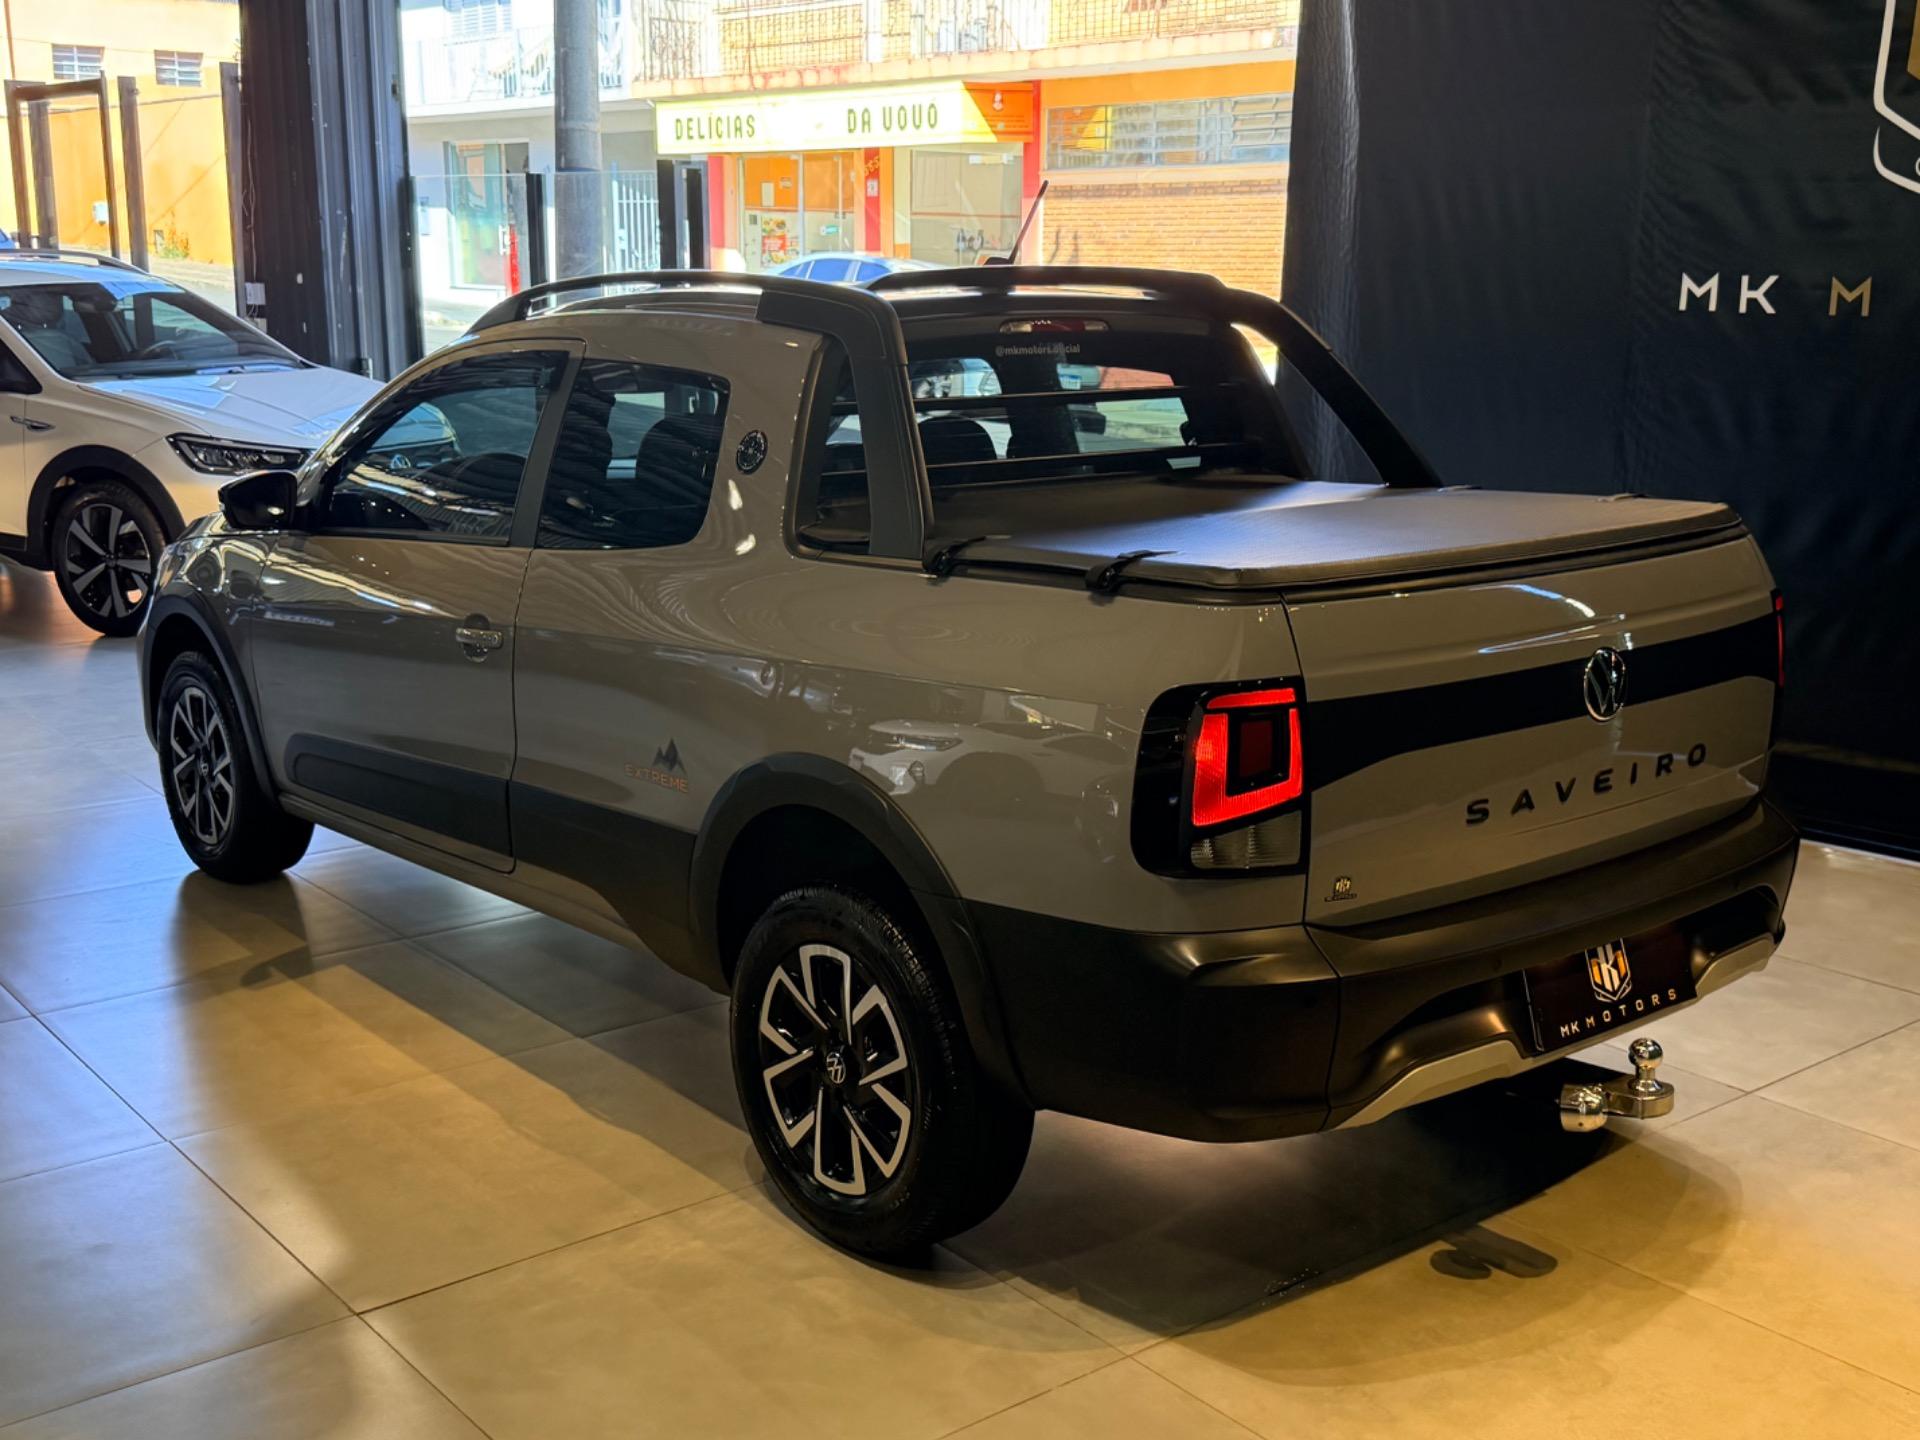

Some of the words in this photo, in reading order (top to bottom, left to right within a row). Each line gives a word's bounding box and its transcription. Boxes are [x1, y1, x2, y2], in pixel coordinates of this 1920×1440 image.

[675, 112, 755, 141] DELÍCIAS
[847, 107, 871, 133] DA
[1678, 272, 1780, 314] MK
[623, 763, 689, 793] EXTREME
[1465, 743, 1707, 825] SAVEIRO
